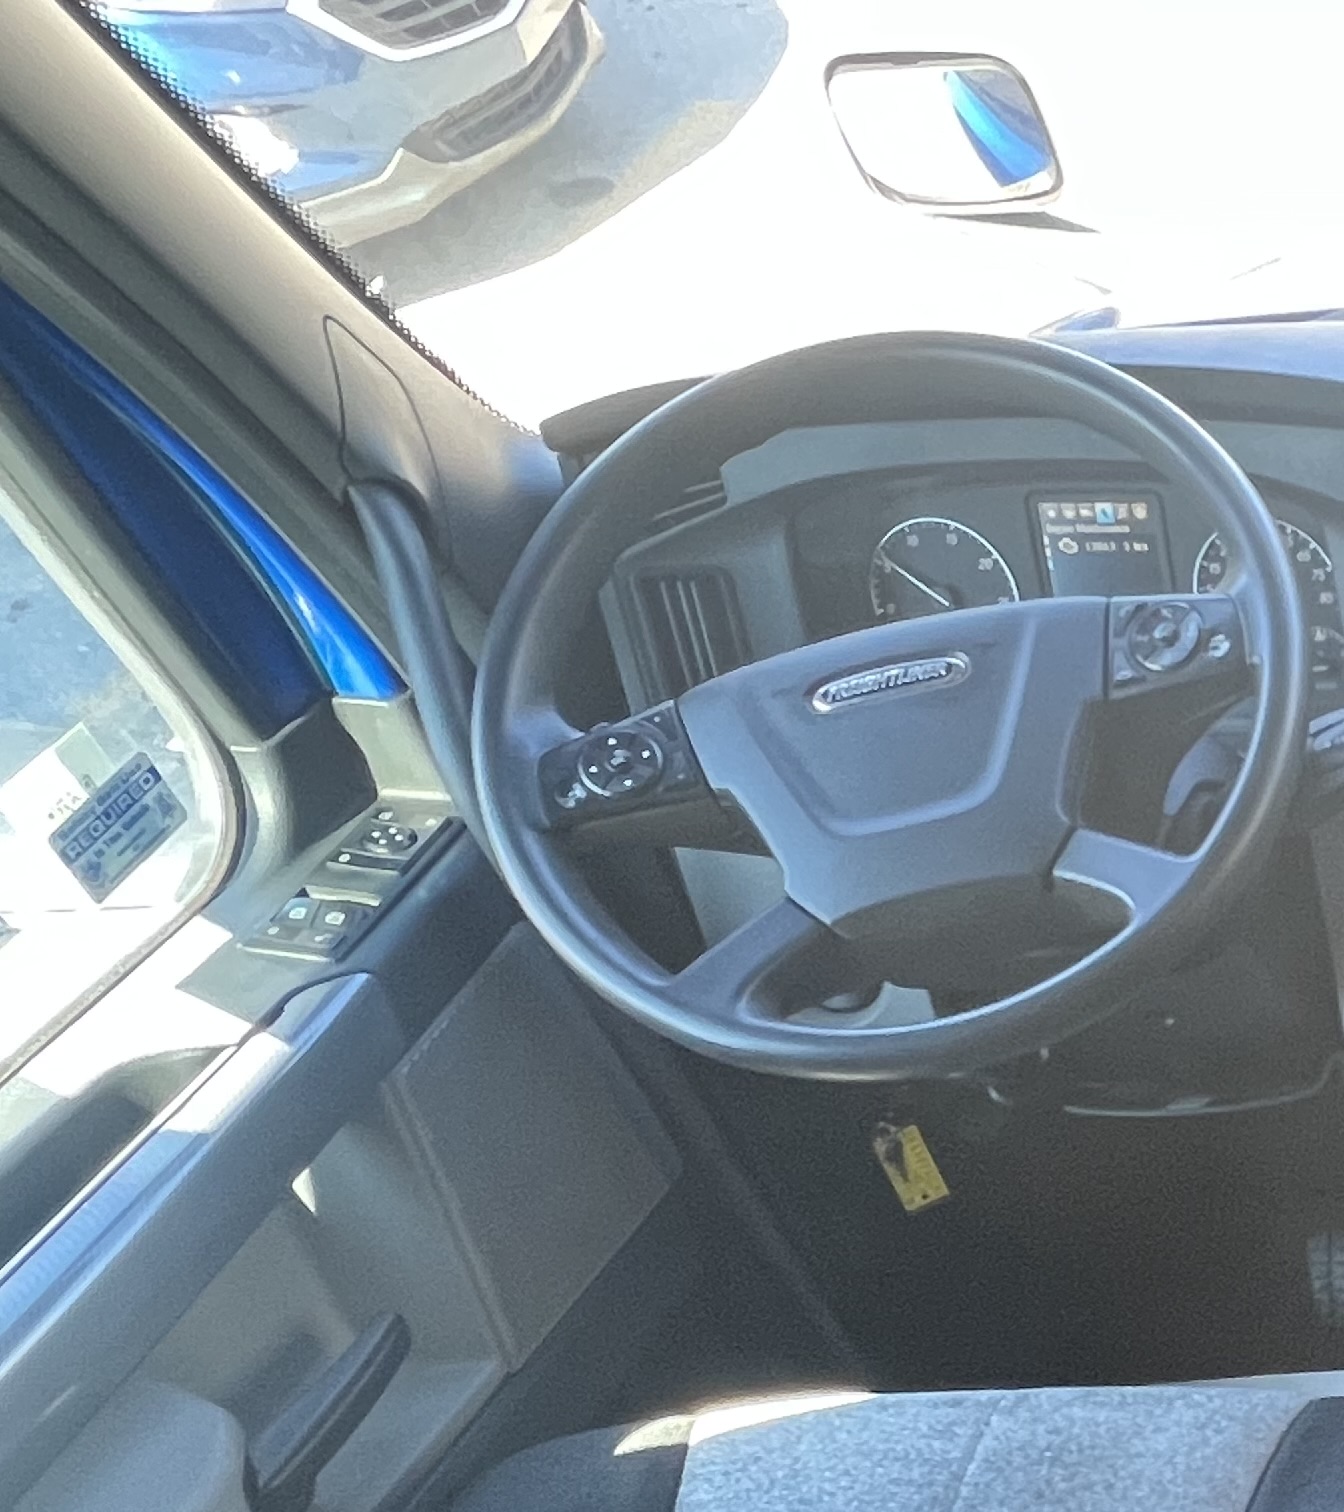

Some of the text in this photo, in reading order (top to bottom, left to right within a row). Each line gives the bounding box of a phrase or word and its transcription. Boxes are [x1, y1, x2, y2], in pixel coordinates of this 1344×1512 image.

[978, 557, 994, 570] 20
[825, 660, 951, 703] FREIGHTLINER
[63, 771, 155, 861] REQUIRED
